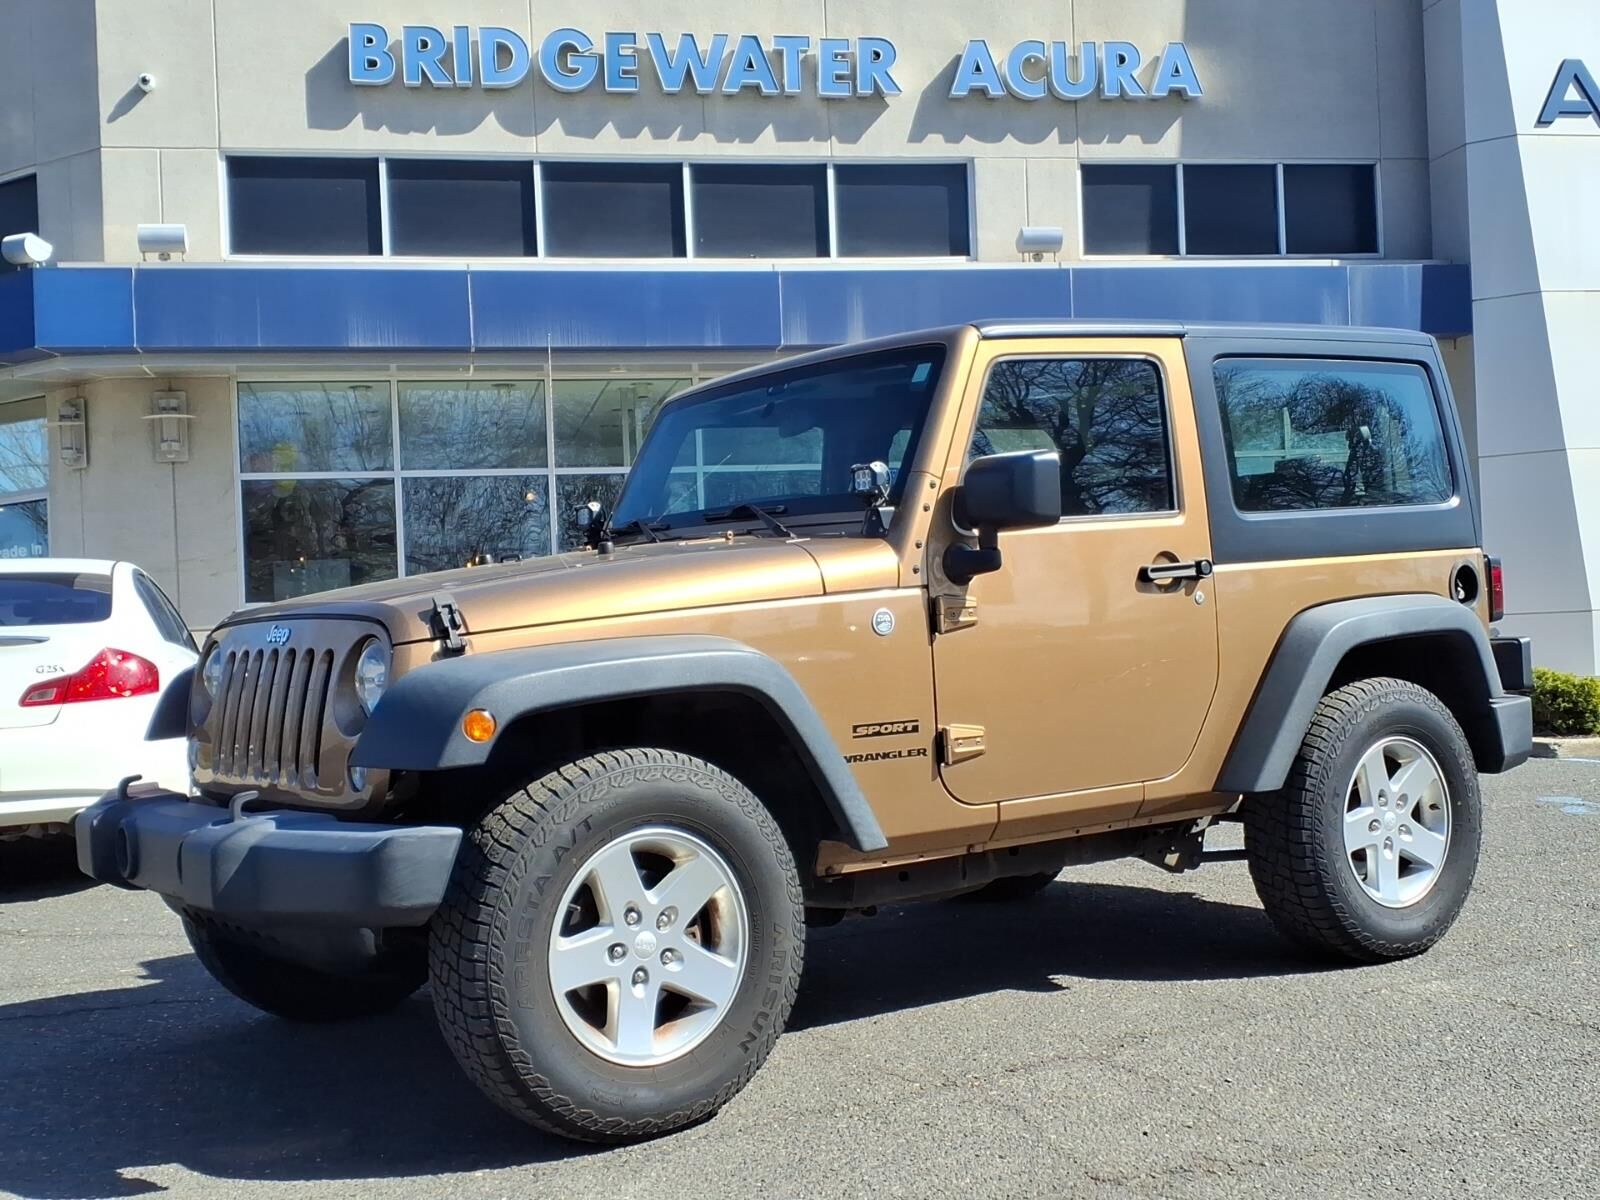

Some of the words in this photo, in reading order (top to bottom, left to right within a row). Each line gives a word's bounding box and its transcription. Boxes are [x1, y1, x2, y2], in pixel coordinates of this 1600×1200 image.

[348, 23, 902, 98] BRIDGEWATER
[949, 39, 1203, 101] ACURA
[0, 544, 28, 558] ade
[266, 624, 291, 646] Jeep
[853, 722, 918, 737] SPORT
[553, 814, 594, 865] A/T
[736, 922, 788, 1054] ARISUN
